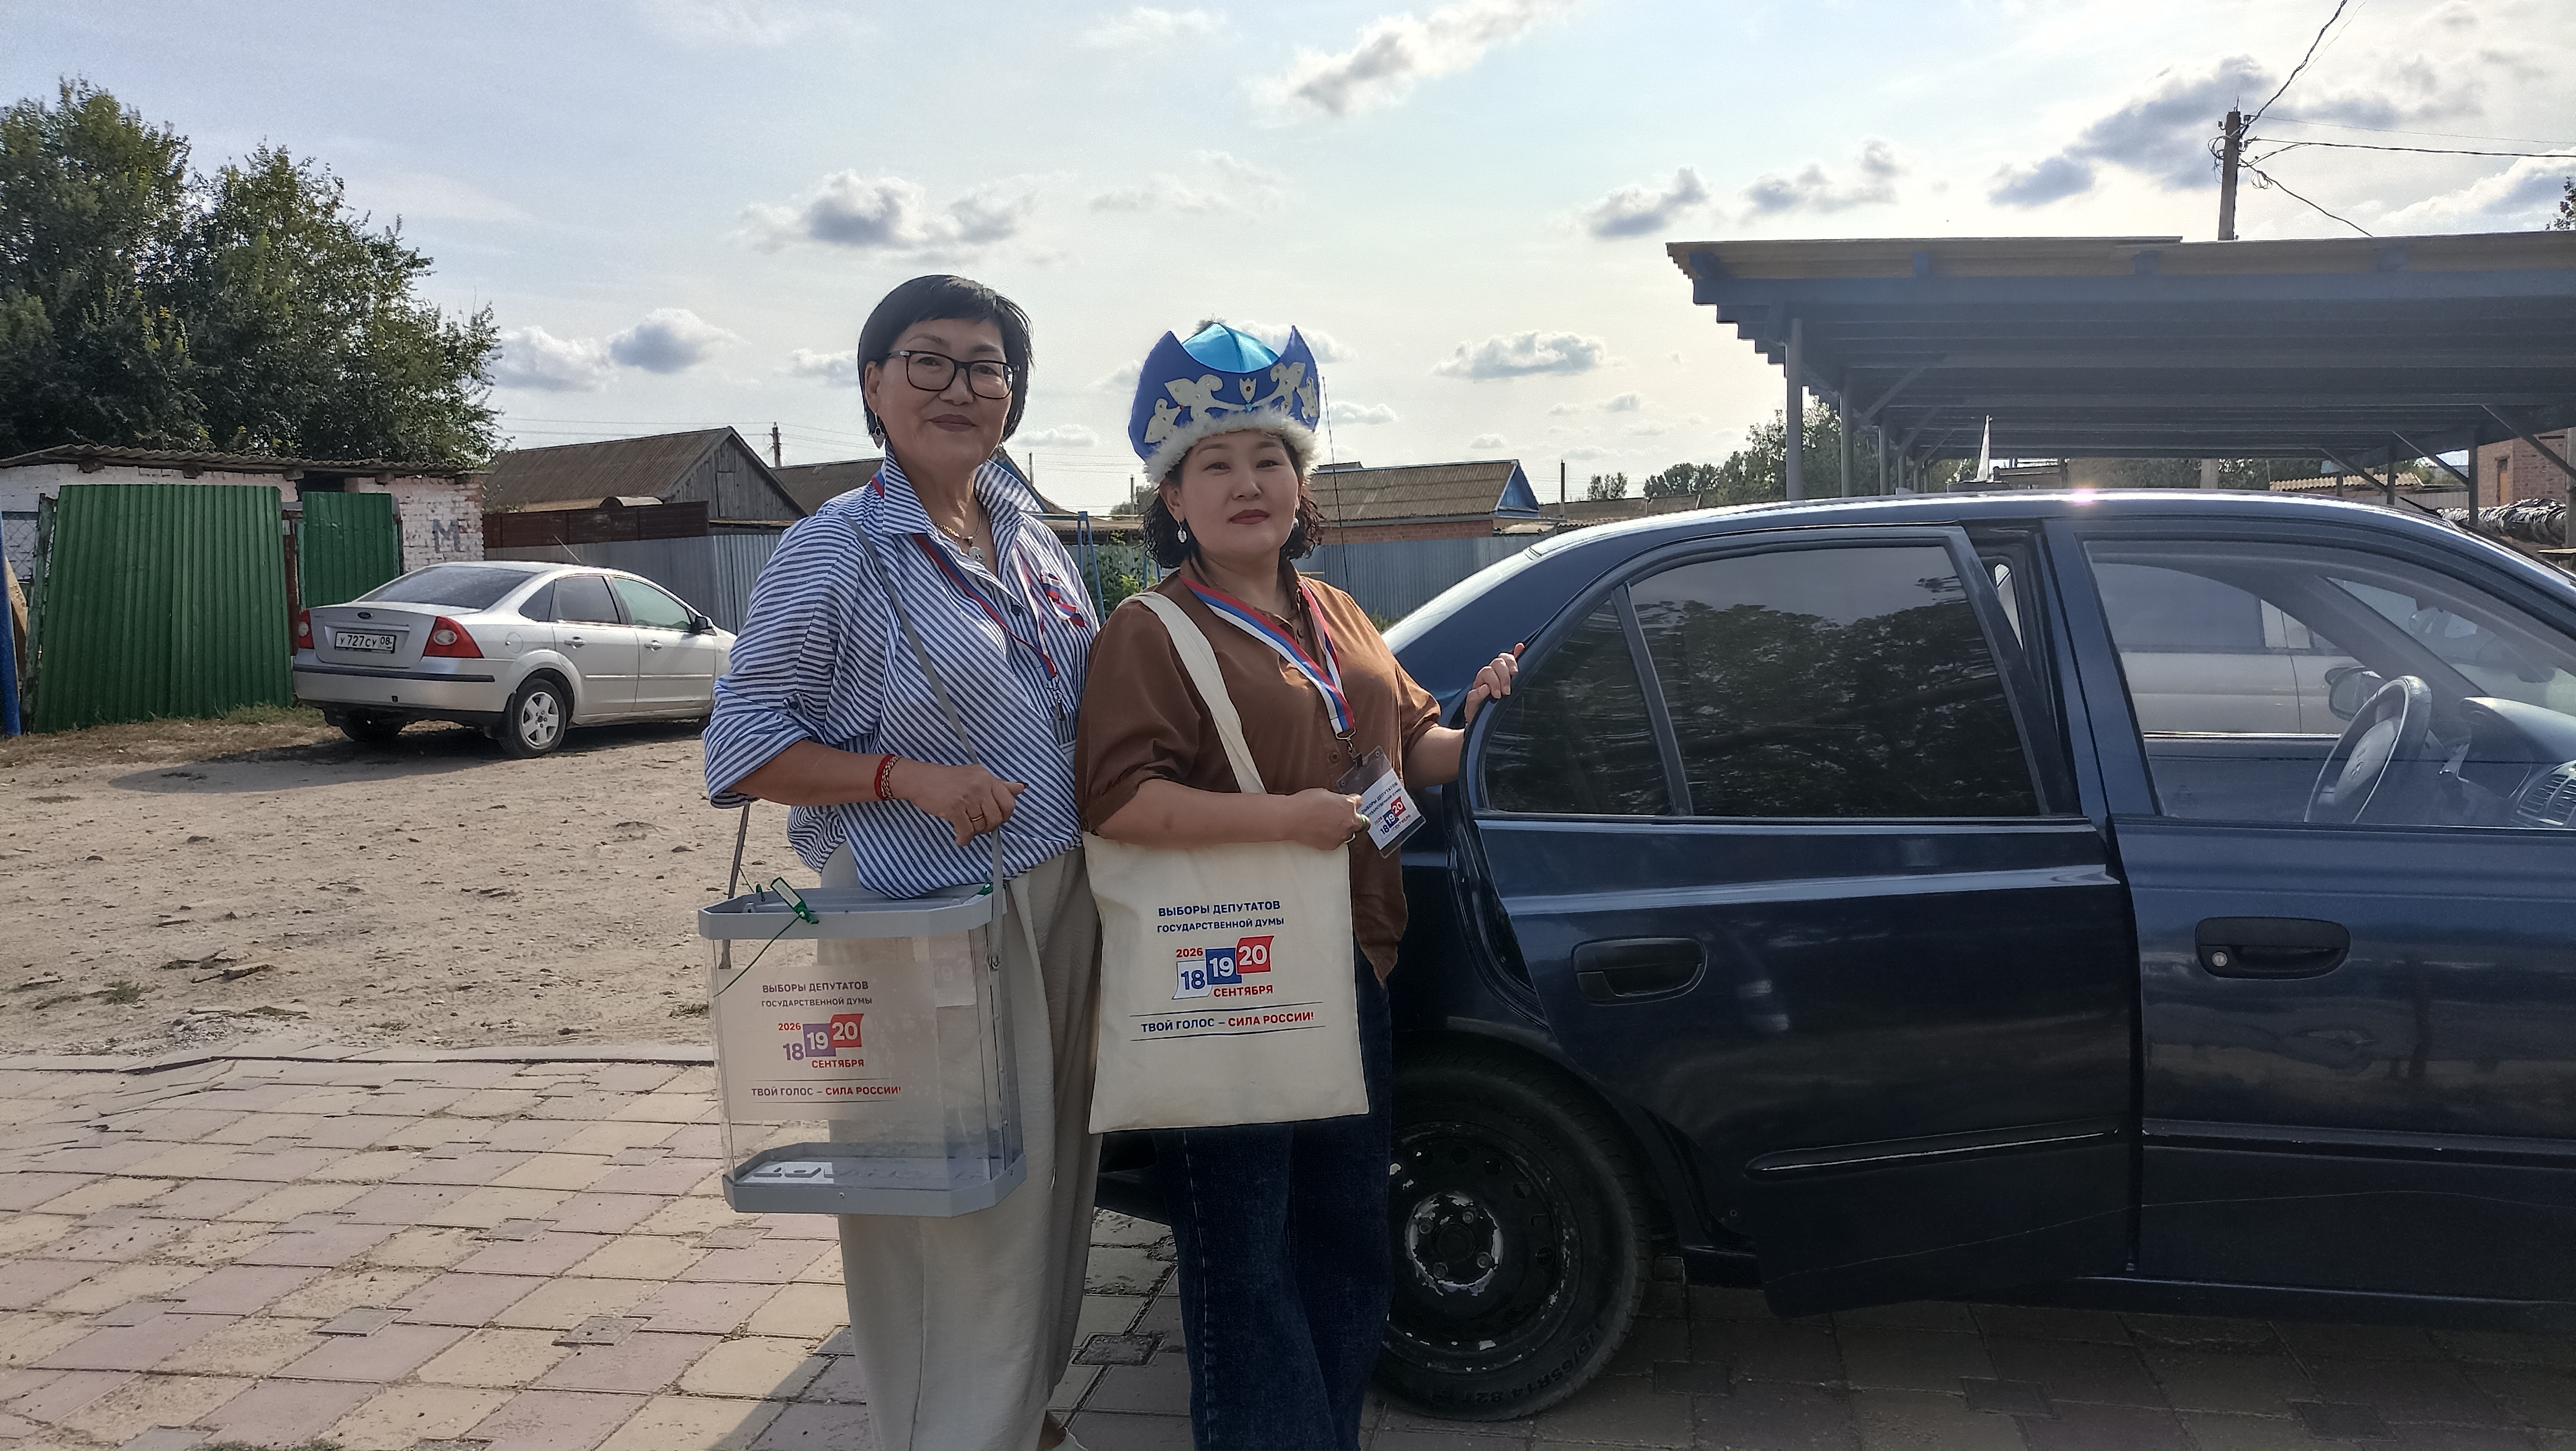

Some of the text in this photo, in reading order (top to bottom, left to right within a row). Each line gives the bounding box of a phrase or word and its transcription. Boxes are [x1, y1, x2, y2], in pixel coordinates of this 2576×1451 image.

[1380, 801, 1403, 835] 18 19 20
[1158, 900, 1280, 917] ВЫБОРЫ ДЕПУТАТОВ
[1157, 918, 1284, 933] ГОСУДАРСТВЕННОЙ ДУМЫ
[1176, 948, 1203, 957] 2026
[1181, 944, 1267, 990] 18 19 20
[762, 981, 869, 993] ВЫБОРЫ ДЕПУТАТОВ
[1213, 985, 1273, 997] СЕНТЯБРЯ
[761, 997, 844, 1007] ГОСУДАРСТВЕННОЙ
[1141, 1020, 1173, 1032] ТВОЙ
[1177, 1019, 1214, 1030] ГОЛОС
[1228, 1016, 1260, 1026] СИЛА
[1264, 1012, 1314, 1024] РОССИИ!
[783, 1021, 858, 1061] 18 19 20
[812, 1059, 864, 1068] СЕНТЯБРЯ
[752, 1087, 778, 1096] ТВОЙ
[826, 1087, 853, 1095] СИЛА
[856, 1086, 901, 1095] РОССИИ!
